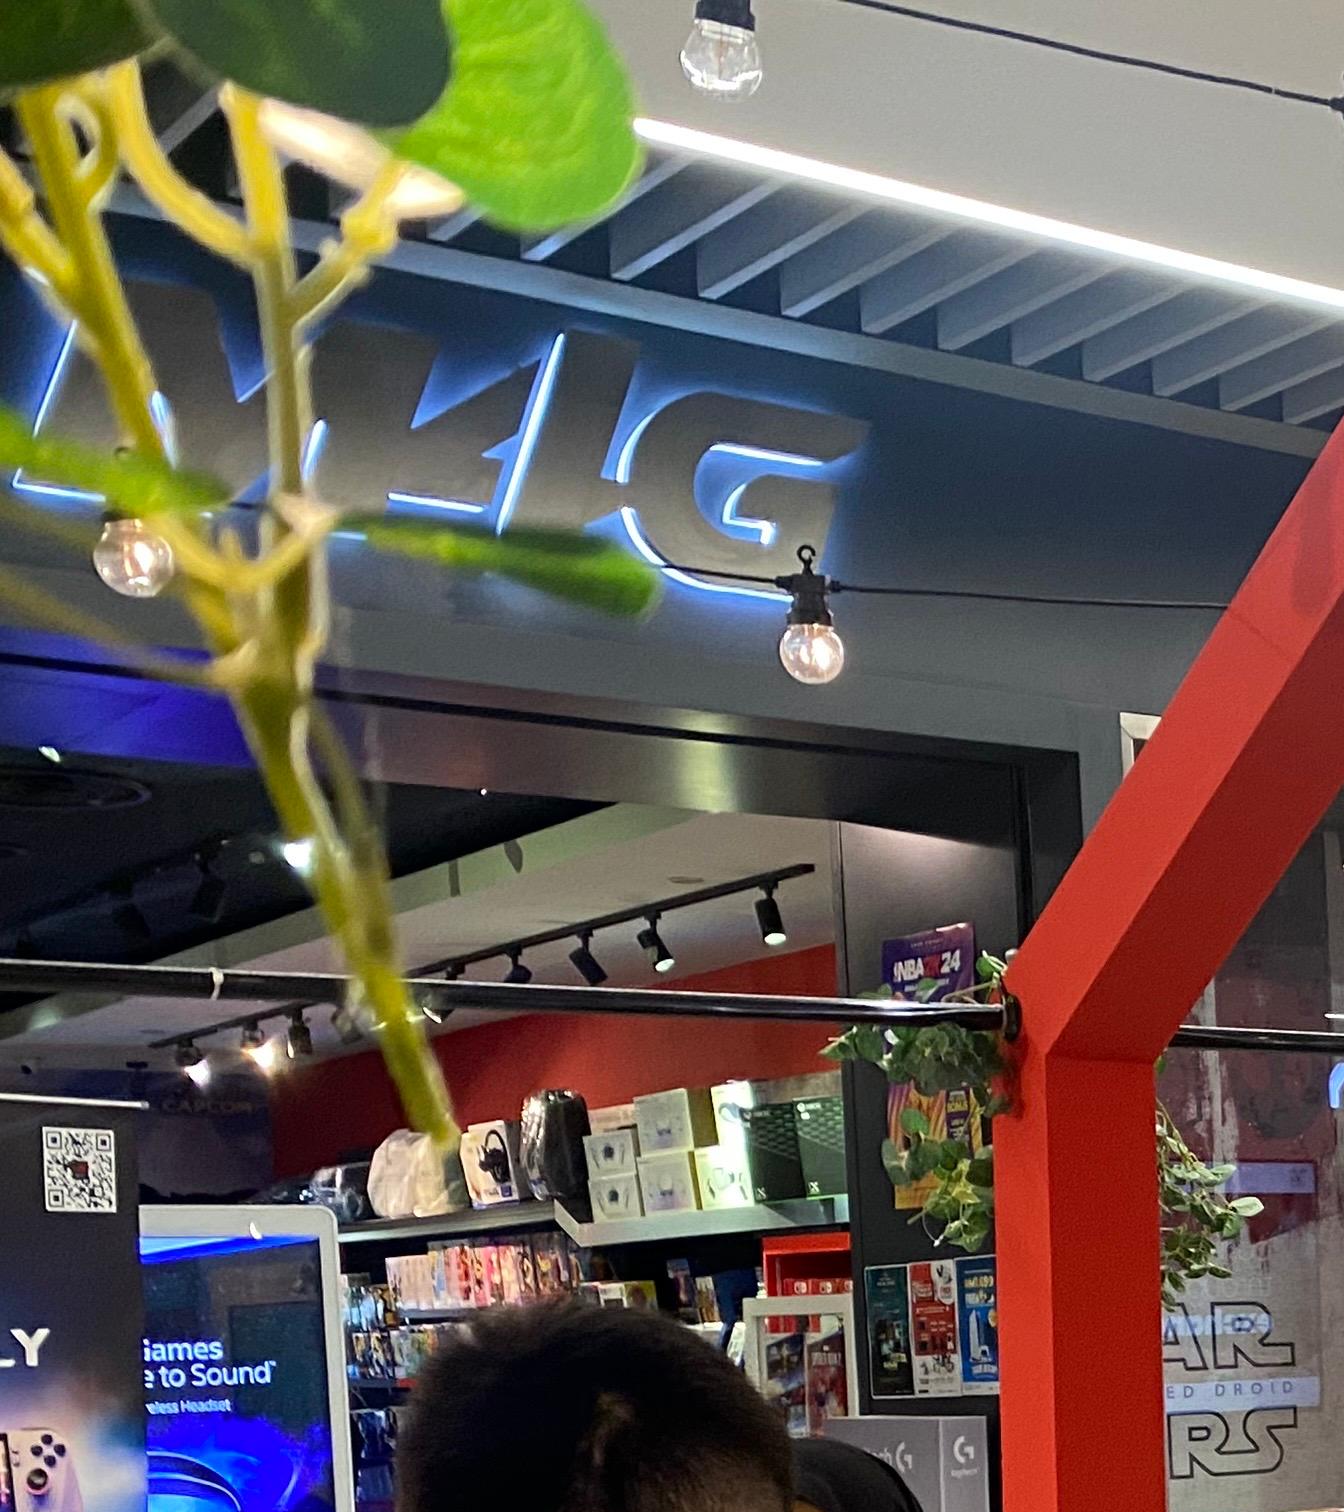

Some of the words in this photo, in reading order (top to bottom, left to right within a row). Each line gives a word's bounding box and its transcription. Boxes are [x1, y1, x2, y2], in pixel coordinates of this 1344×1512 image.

[143, 1338, 224, 1362] ames
[159, 1364, 186, 1388] to
[1166, 1382, 1194, 1399] ED
[1215, 1379, 1294, 1397] DROID
